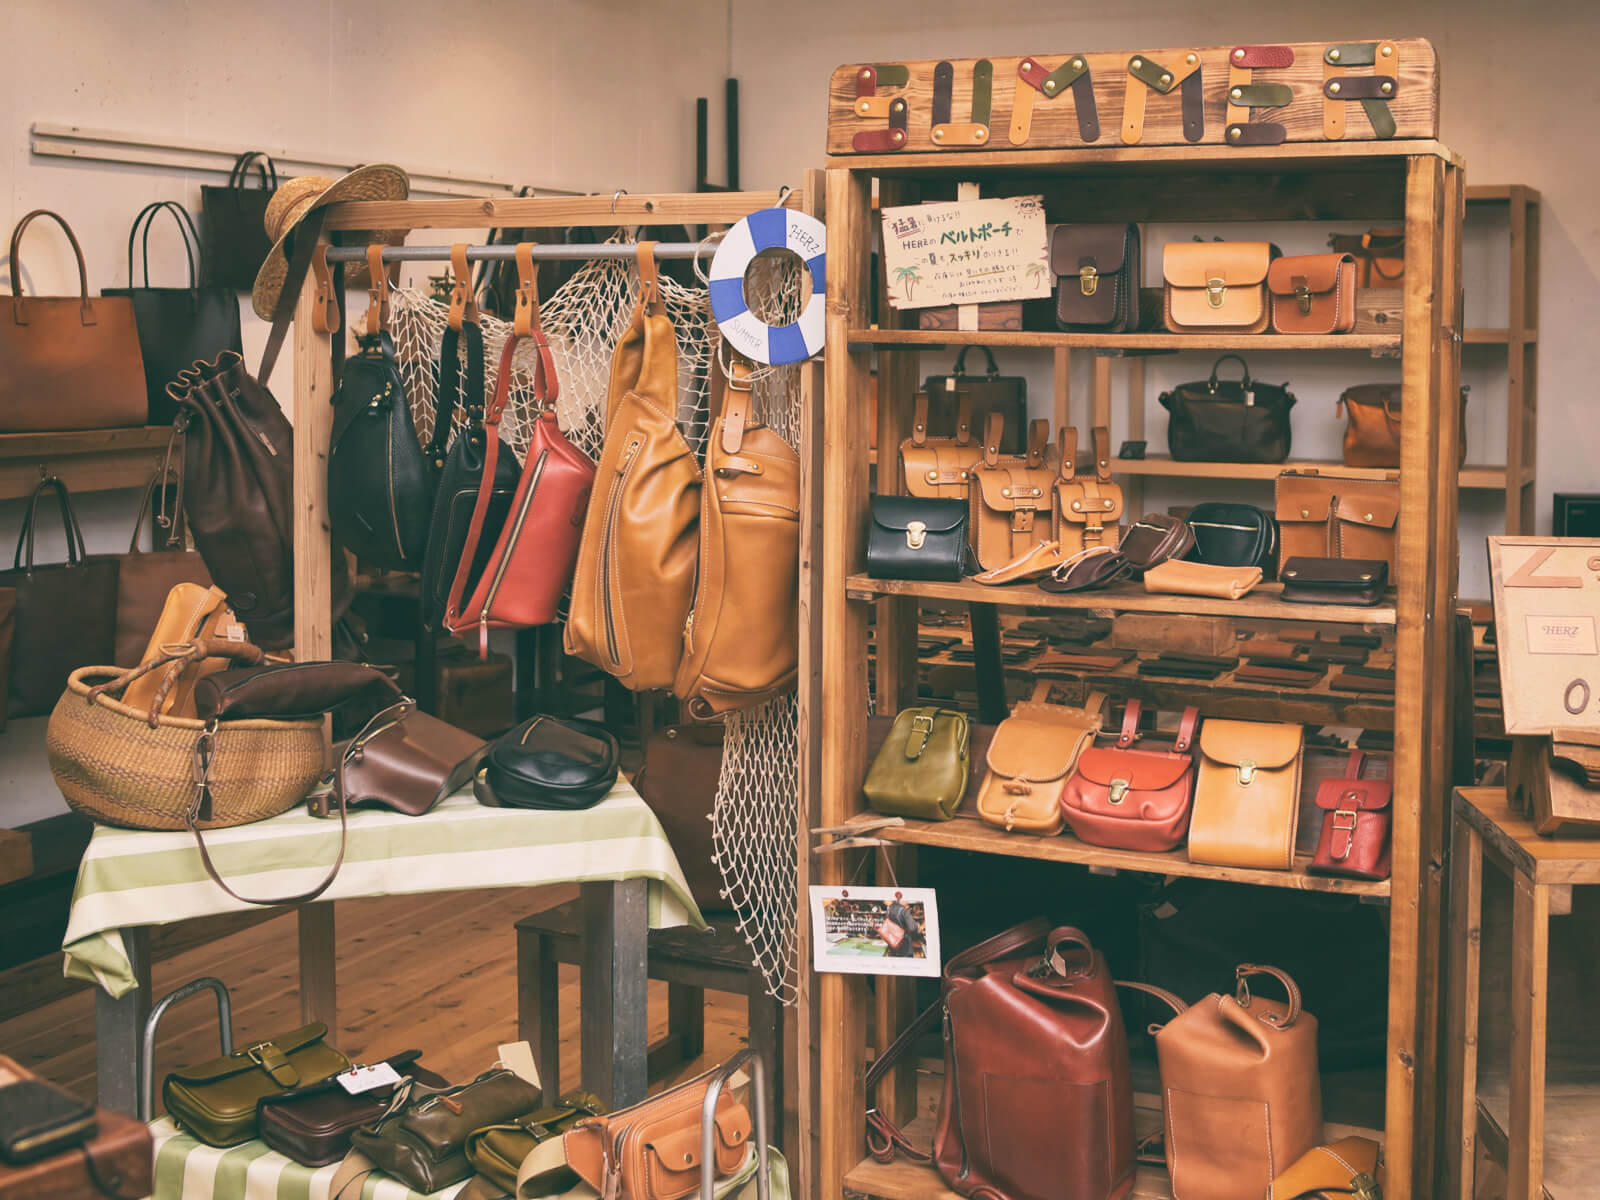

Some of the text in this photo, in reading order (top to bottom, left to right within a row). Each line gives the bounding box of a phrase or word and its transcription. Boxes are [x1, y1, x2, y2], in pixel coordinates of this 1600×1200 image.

[852, 41, 1397, 152] SUMMER
[788, 224, 820, 254] HERZ
[730, 319, 763, 352] SUMMER
[1542, 625, 1579, 638] HERZ
